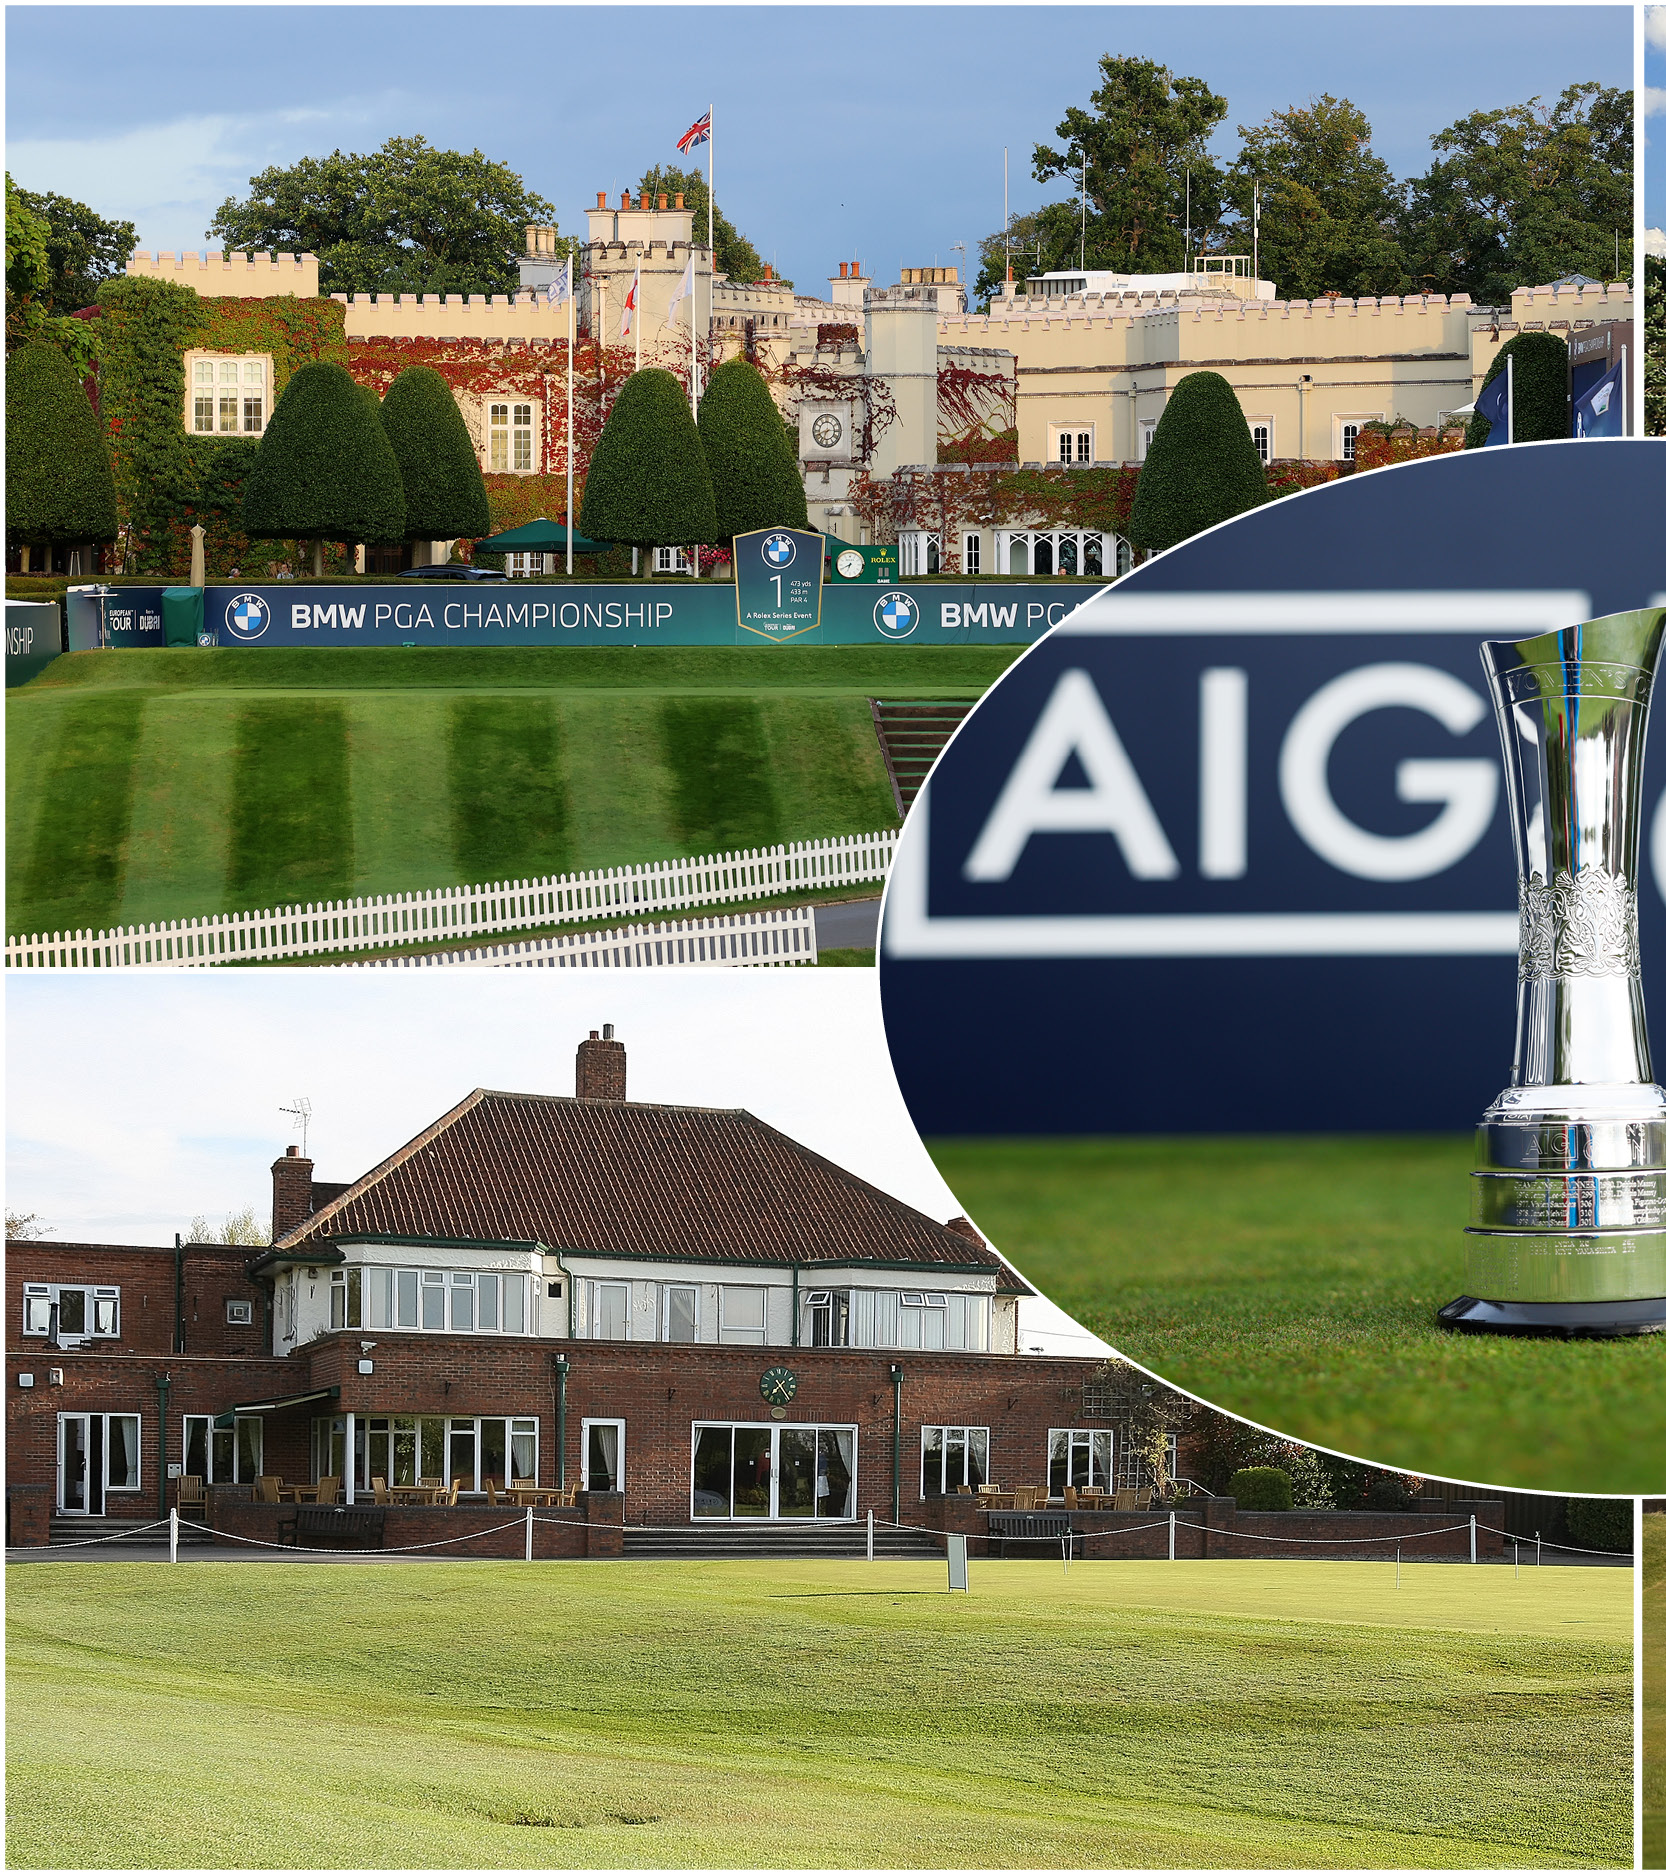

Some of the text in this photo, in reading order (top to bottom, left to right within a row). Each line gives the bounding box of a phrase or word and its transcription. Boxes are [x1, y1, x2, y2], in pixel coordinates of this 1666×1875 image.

[766, 536, 792, 546] BMW
[769, 575, 781, 608] 1
[232, 596, 264, 609] BMW
[880, 594, 914, 608] BMW
[291, 603, 673, 629] BMW PGA CHAMPIONSHIP
[941, 602, 1083, 628] BMW PG
[109, 617, 132, 631] TOUR
[139, 615, 160, 631] DUBAI
[1504, 668, 1627, 693] WOMEN'S
[962, 662, 1489, 884] AIG
[1525, 1133, 1571, 1156] AIG
[1581, 1191, 1594, 1199] 299
[1580, 1200, 1593, 1208] 306
[1580, 1209, 1593, 1217] 310
[1580, 1218, 1592, 1226] 301
